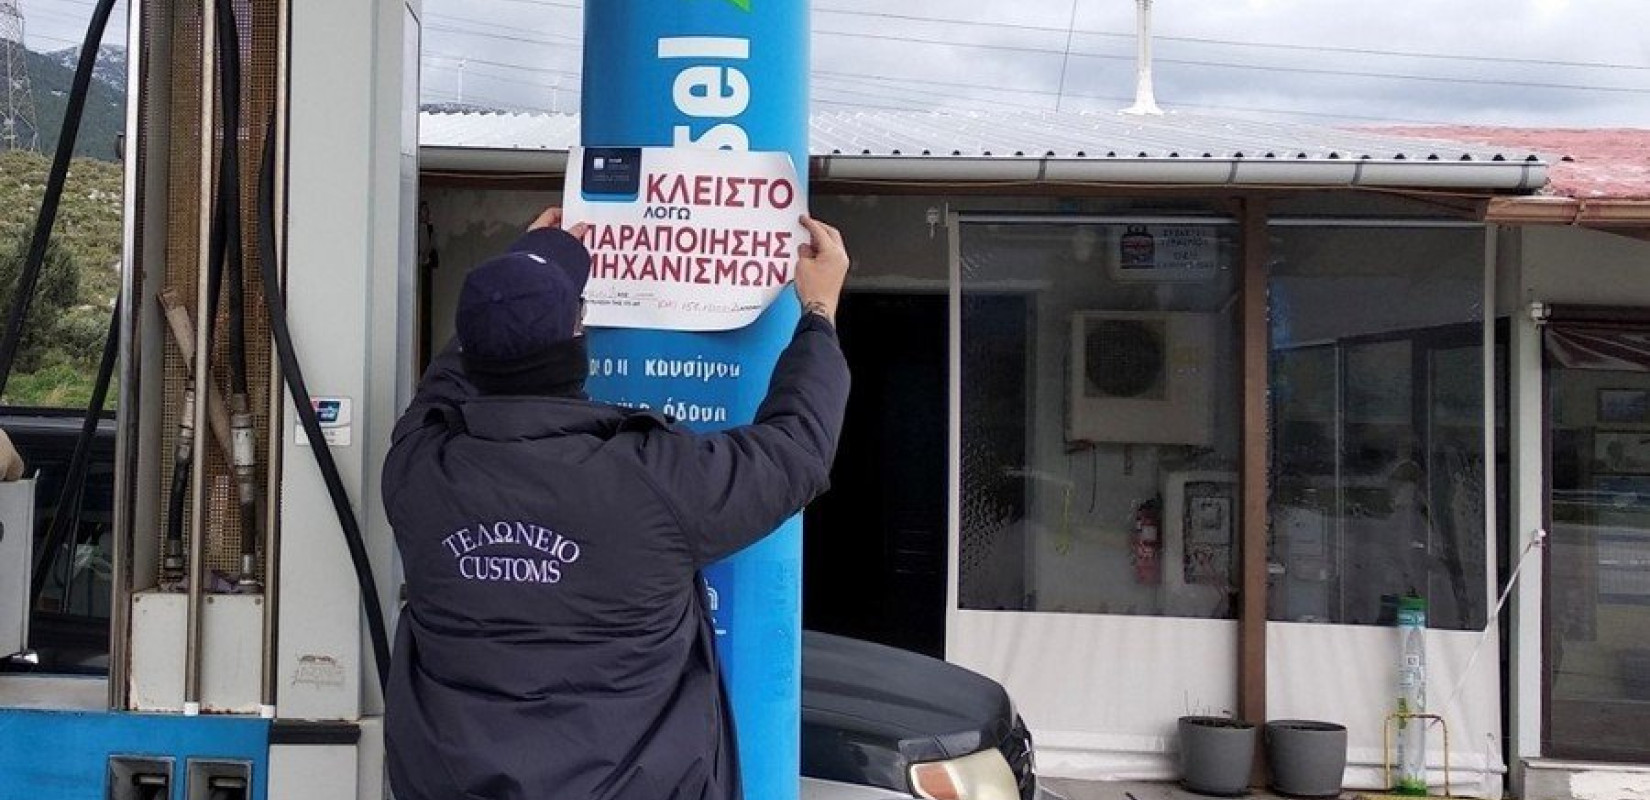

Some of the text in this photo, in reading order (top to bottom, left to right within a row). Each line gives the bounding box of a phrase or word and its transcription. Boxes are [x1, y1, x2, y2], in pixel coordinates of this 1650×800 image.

[646, 173, 794, 210] ΚΛΕΙΣΤΟ
[643, 206, 691, 220] ΛΟΓΩ
[644, 354, 740, 382] καυσίμου
[441, 521, 581, 563] ΤΕΛΩΝΕΙΟ
[459, 555, 562, 584] CUSTOMS
